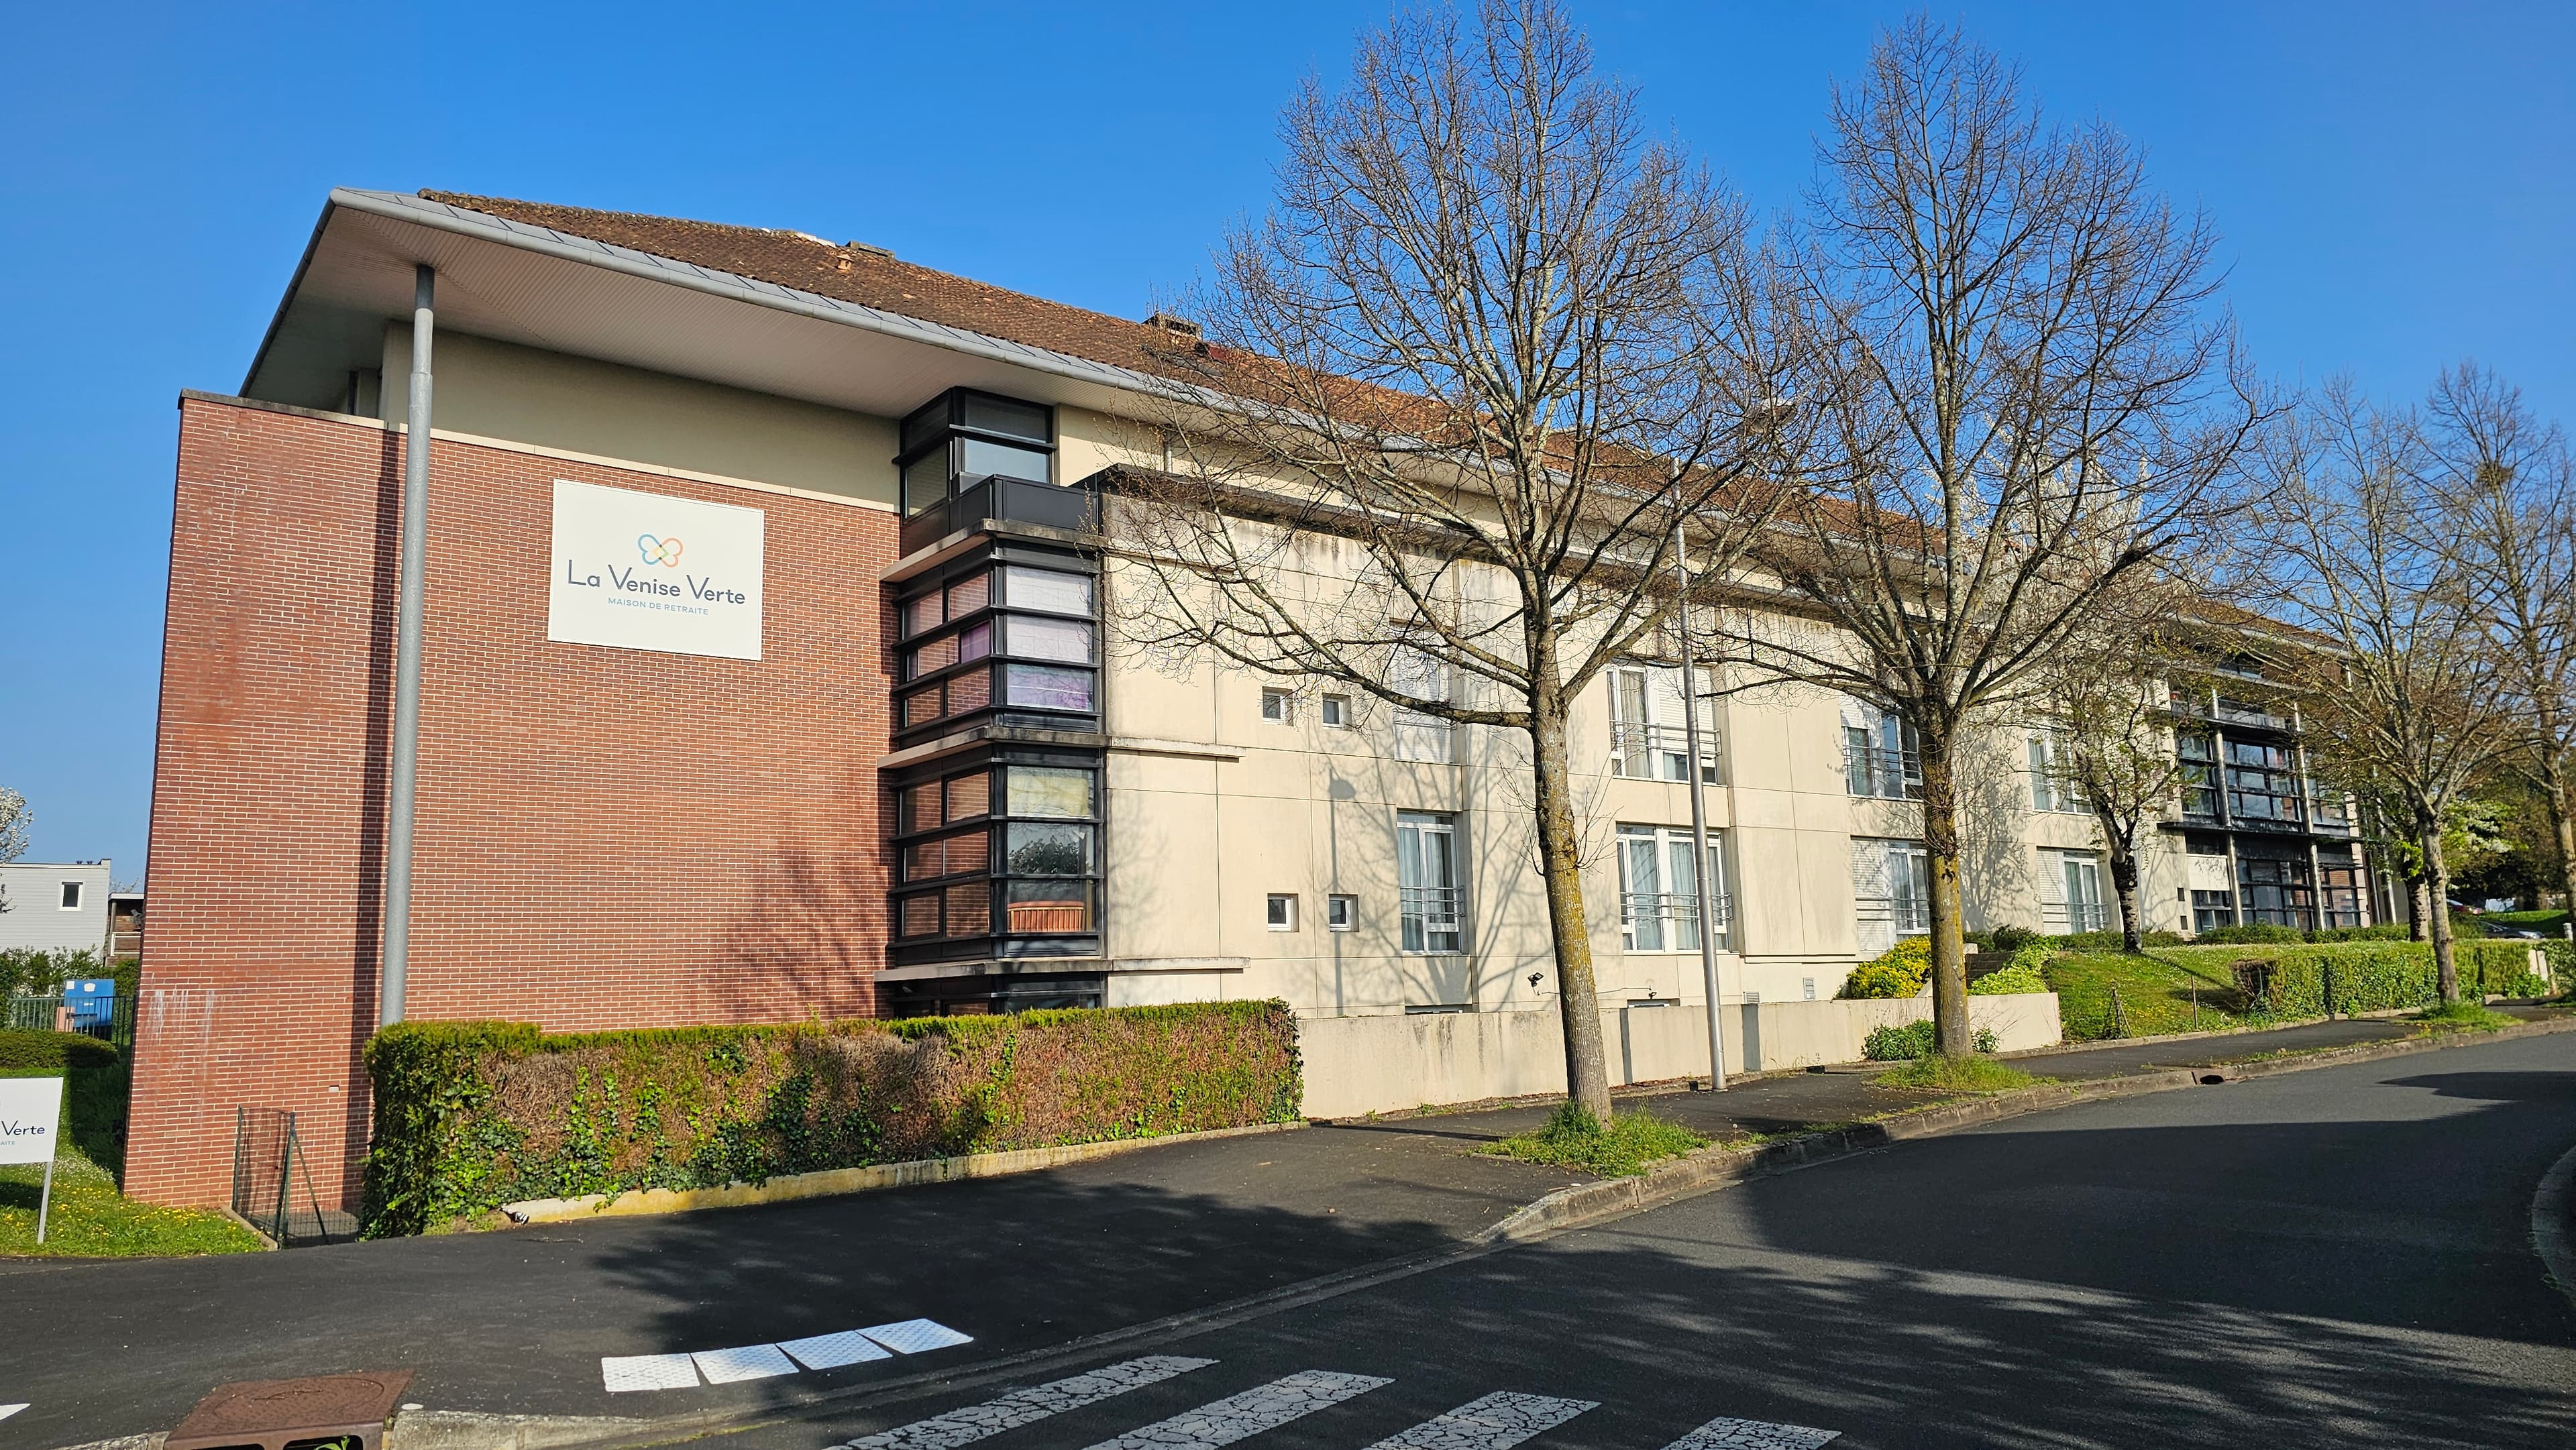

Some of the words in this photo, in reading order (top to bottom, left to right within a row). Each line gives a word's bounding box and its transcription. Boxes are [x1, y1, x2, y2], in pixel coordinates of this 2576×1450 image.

[568, 559, 600, 587] La
[608, 564, 680, 596] Venise
[686, 575, 745, 604] Verte
[608, 598, 646, 608] MAISON
[664, 604, 708, 615] RETRAITE
[1, 1120, 45, 1135] Verte
